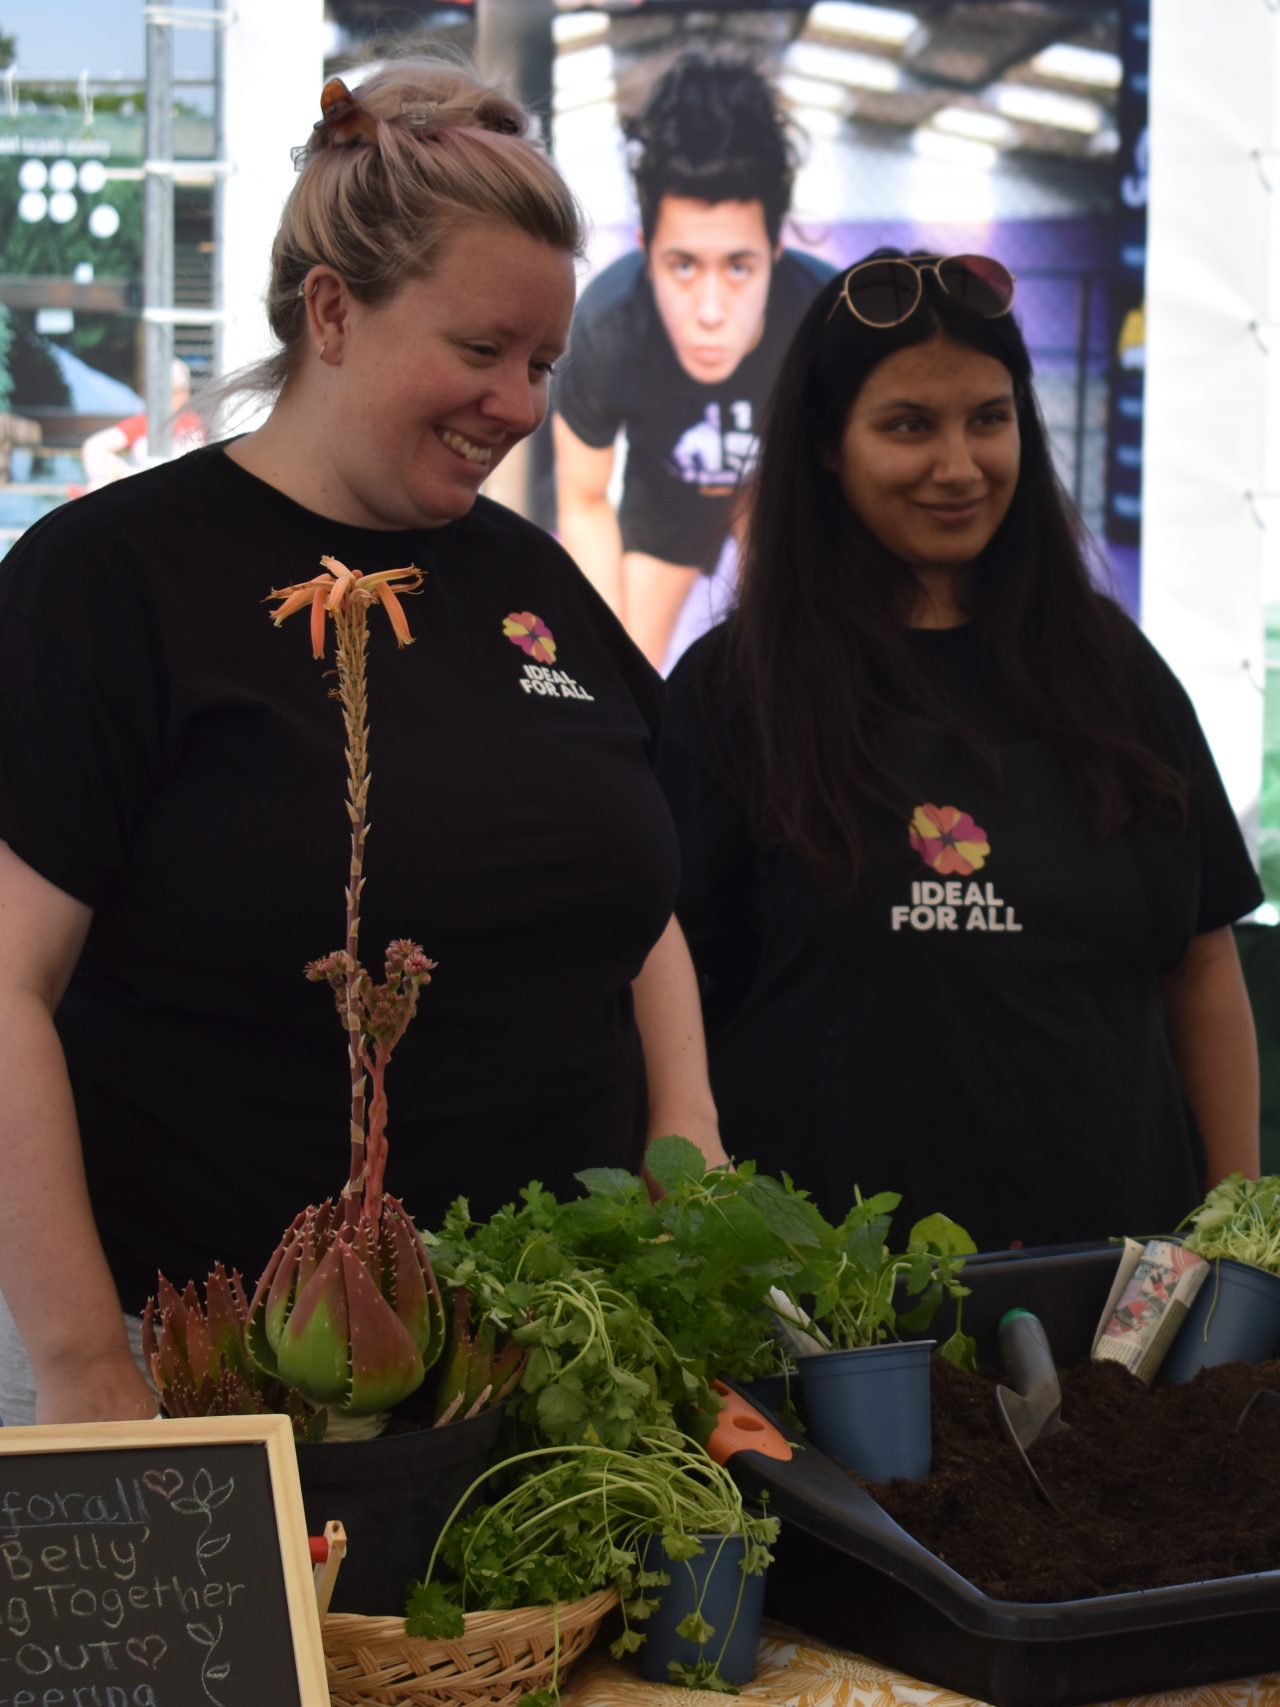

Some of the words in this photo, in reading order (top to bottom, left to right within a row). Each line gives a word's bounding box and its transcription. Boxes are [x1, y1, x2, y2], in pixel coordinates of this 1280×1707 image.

[522, 664, 577, 686] IDEAL
[519, 678, 560, 697] FOR
[560, 683, 595, 701] ALL
[911, 881, 1004, 906] IDEAL
[891, 906, 959, 931] FOR
[965, 906, 1024, 931] ALL
[34, 1576, 247, 1629] Together
